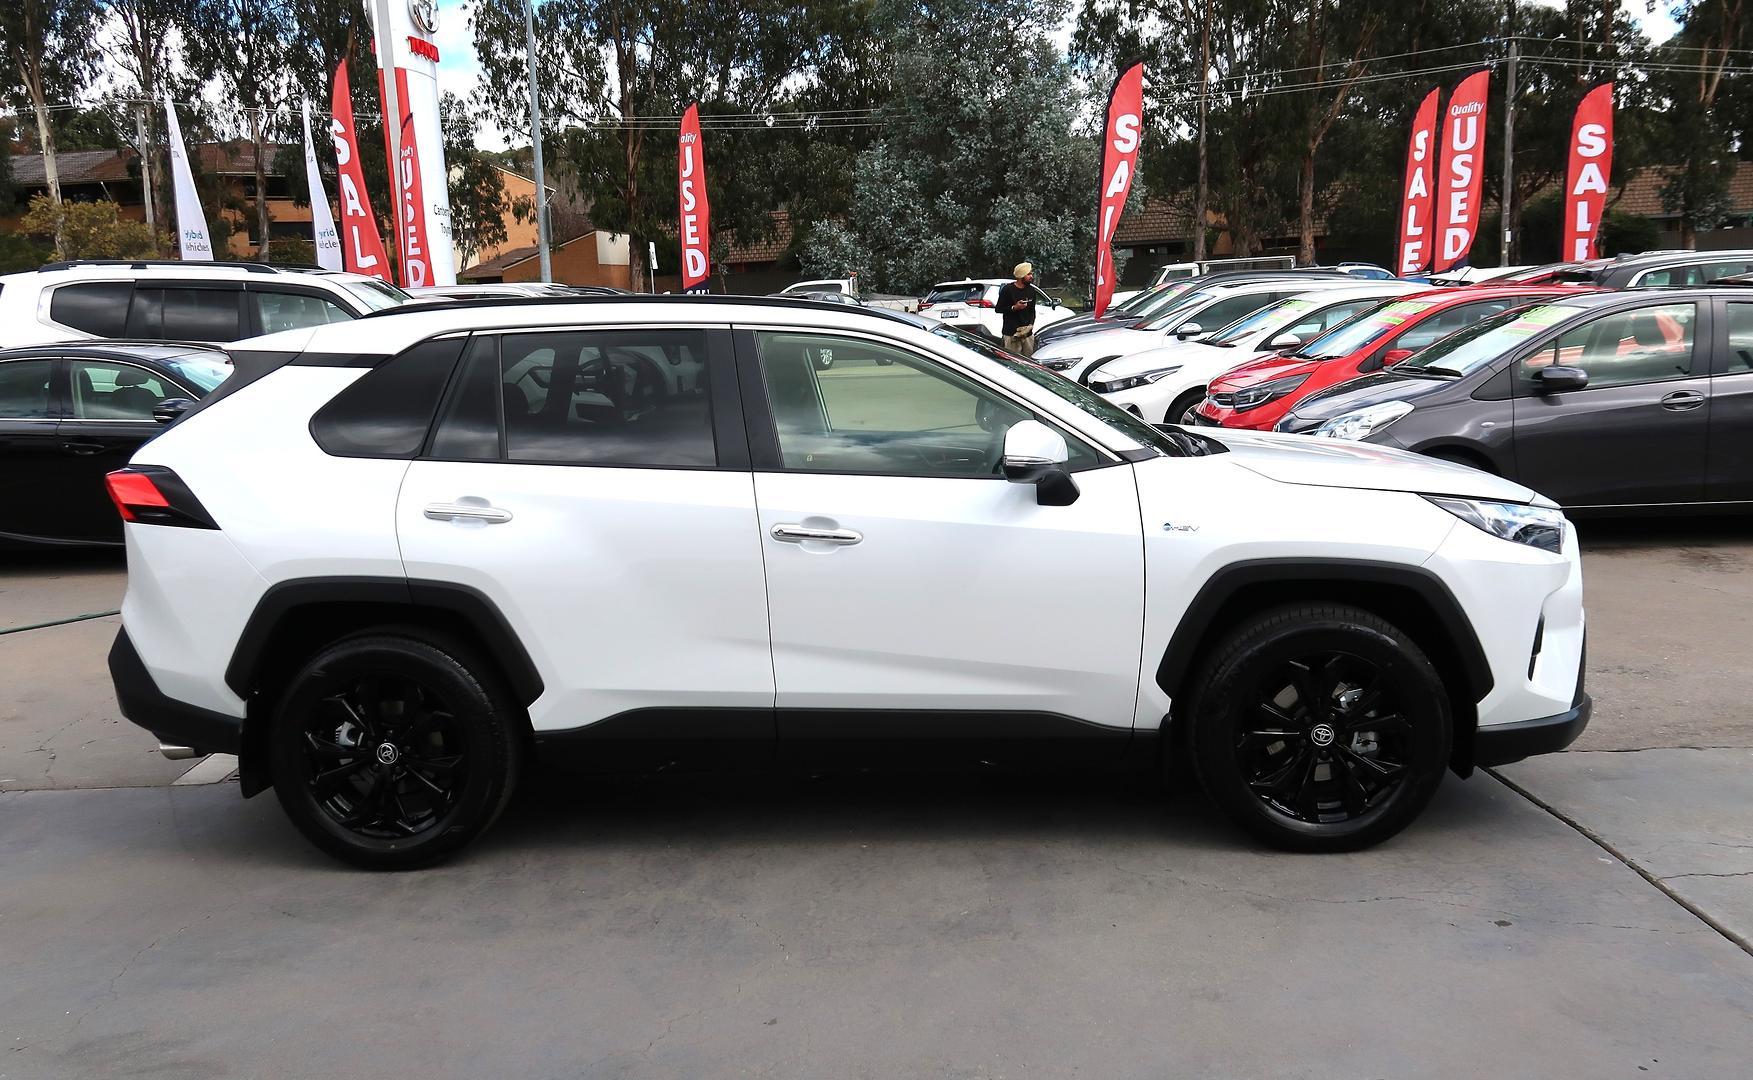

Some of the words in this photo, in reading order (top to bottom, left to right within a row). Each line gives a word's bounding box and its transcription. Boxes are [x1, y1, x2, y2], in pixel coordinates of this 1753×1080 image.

[680, 132, 697, 145] ality
[1451, 101, 1485, 116] Quality
[333, 119, 384, 280] SAL
[1098, 114, 1140, 286] SAL
[1401, 129, 1429, 273] SALE
[1444, 116, 1477, 261] USED
